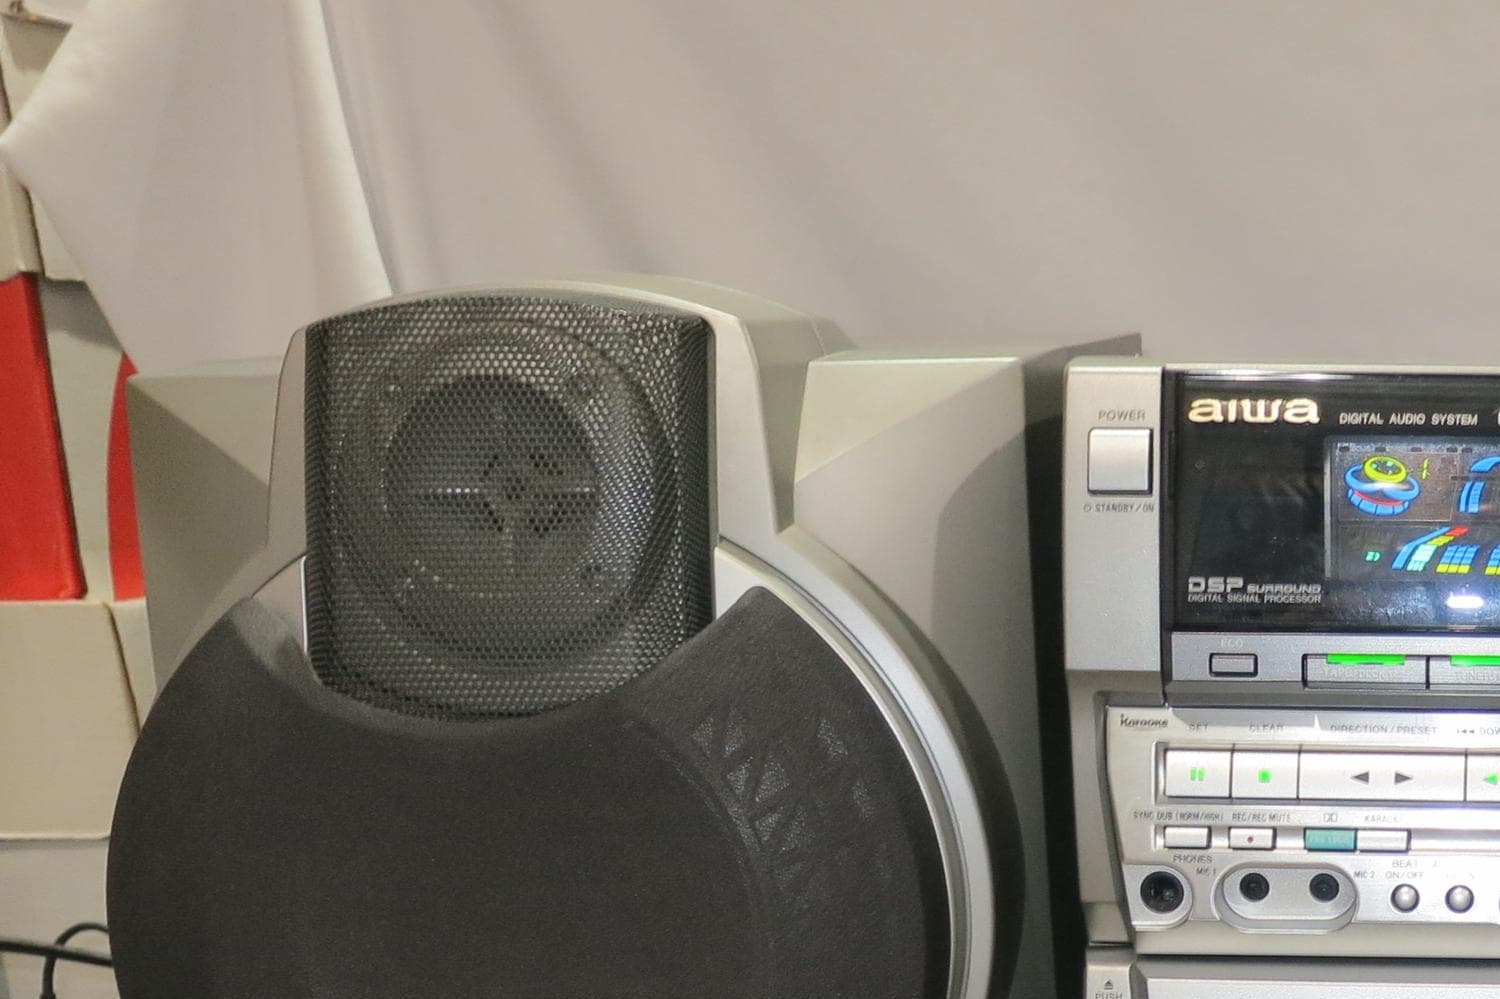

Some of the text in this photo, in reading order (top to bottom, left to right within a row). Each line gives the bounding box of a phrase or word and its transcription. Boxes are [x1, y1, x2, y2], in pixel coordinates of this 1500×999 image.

[1097, 408, 1147, 421] POWER
[1188, 398, 1320, 424] aiwa
[1339, 412, 1478, 426] DIGITAL AUDIO SYSTEM
[1188, 576, 1322, 594] DSP SURROUND
[1188, 594, 1321, 604] DIGITAL SIGNAL PROCESSOR
[1172, 853, 1213, 864] PHONES
[1385, 871, 1425, 880] ON/OFF
